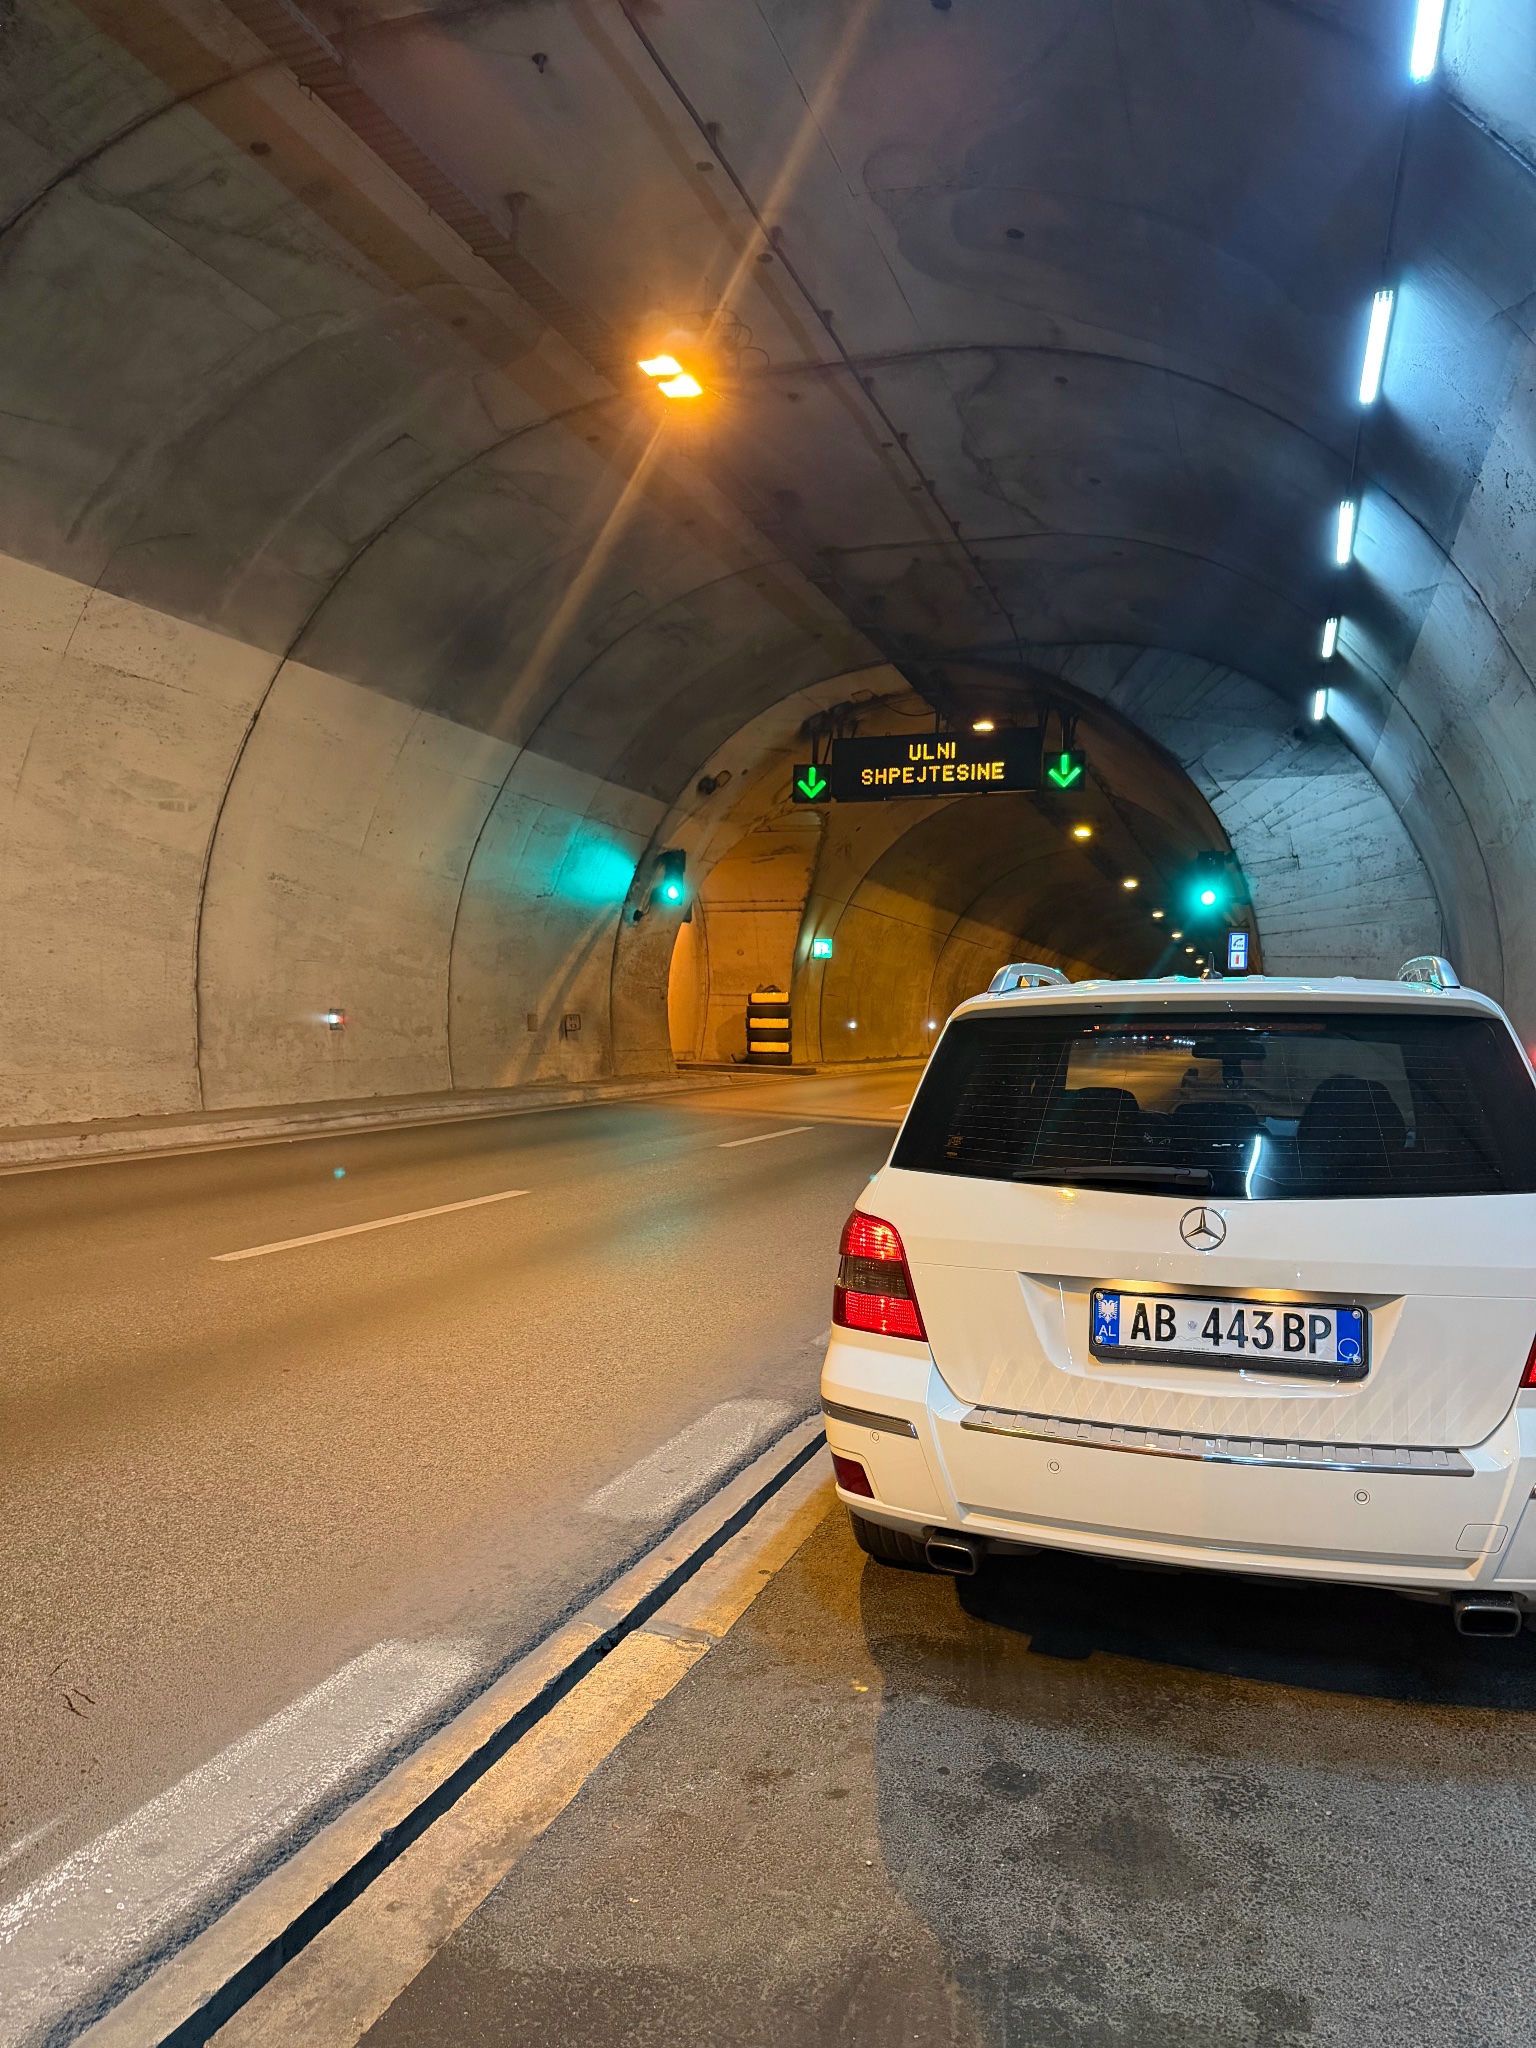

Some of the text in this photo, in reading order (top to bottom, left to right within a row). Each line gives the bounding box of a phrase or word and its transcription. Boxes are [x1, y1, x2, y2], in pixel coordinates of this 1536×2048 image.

[908, 741, 956, 761] ULNI
[861, 761, 1005, 786] SHPEJTESINE
[1098, 1324, 1117, 1337] AL
[1130, 1302, 1177, 1342] AB
